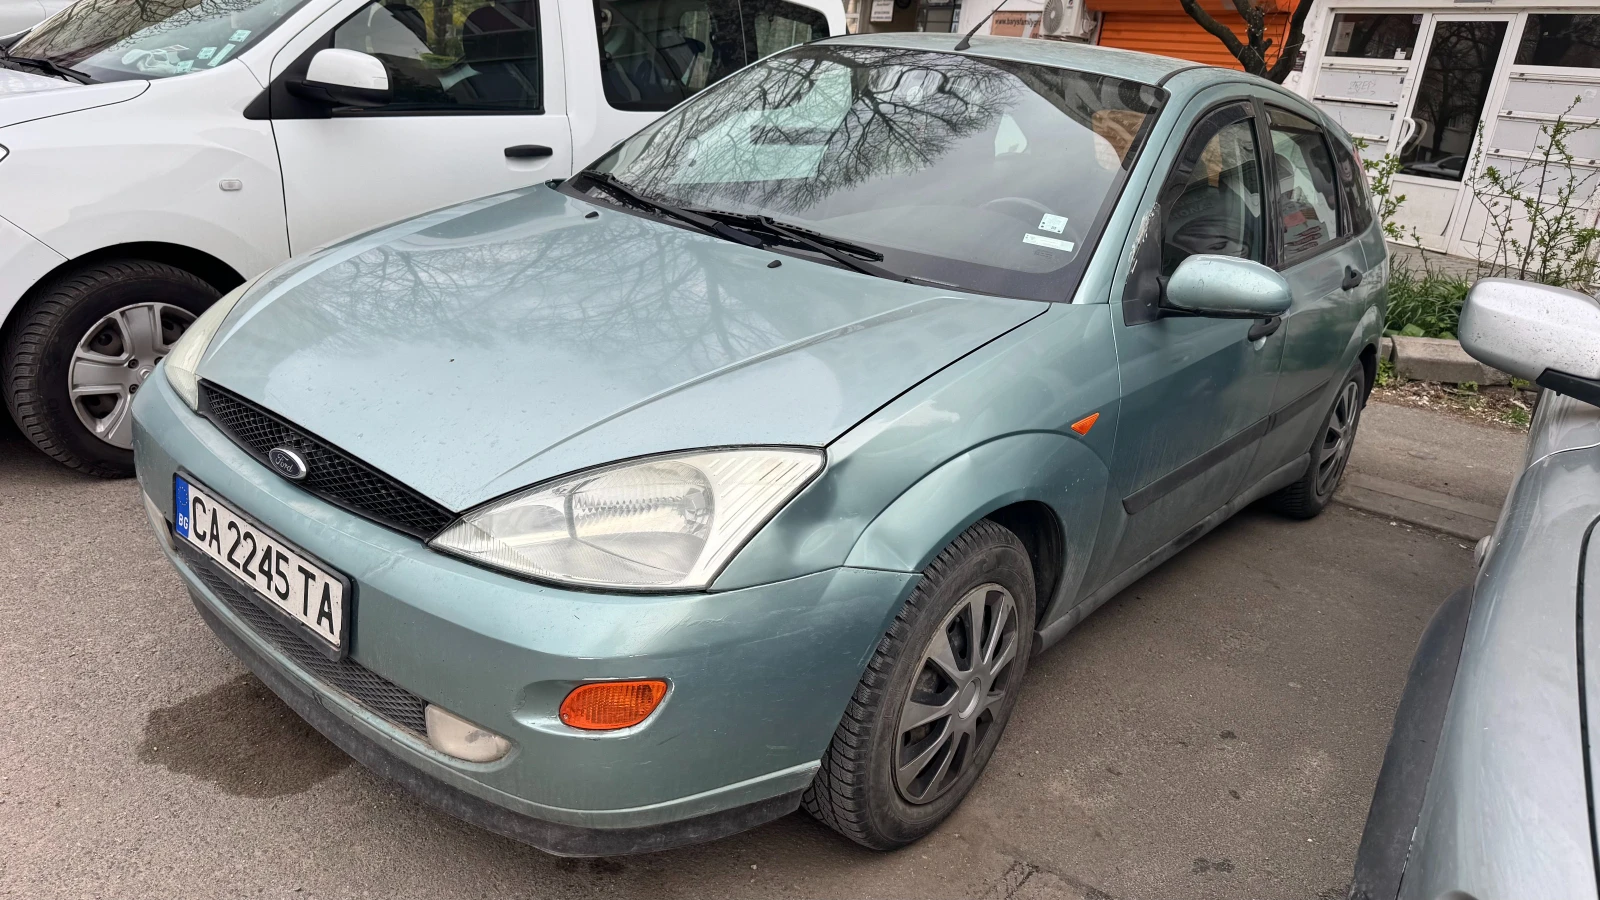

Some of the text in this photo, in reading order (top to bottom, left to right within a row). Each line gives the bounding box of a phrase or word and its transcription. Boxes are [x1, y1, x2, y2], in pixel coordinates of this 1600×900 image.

[274, 455, 294, 473] Ford
[178, 512, 189, 530] BG
[192, 496, 335, 636] CA 2245 TA
